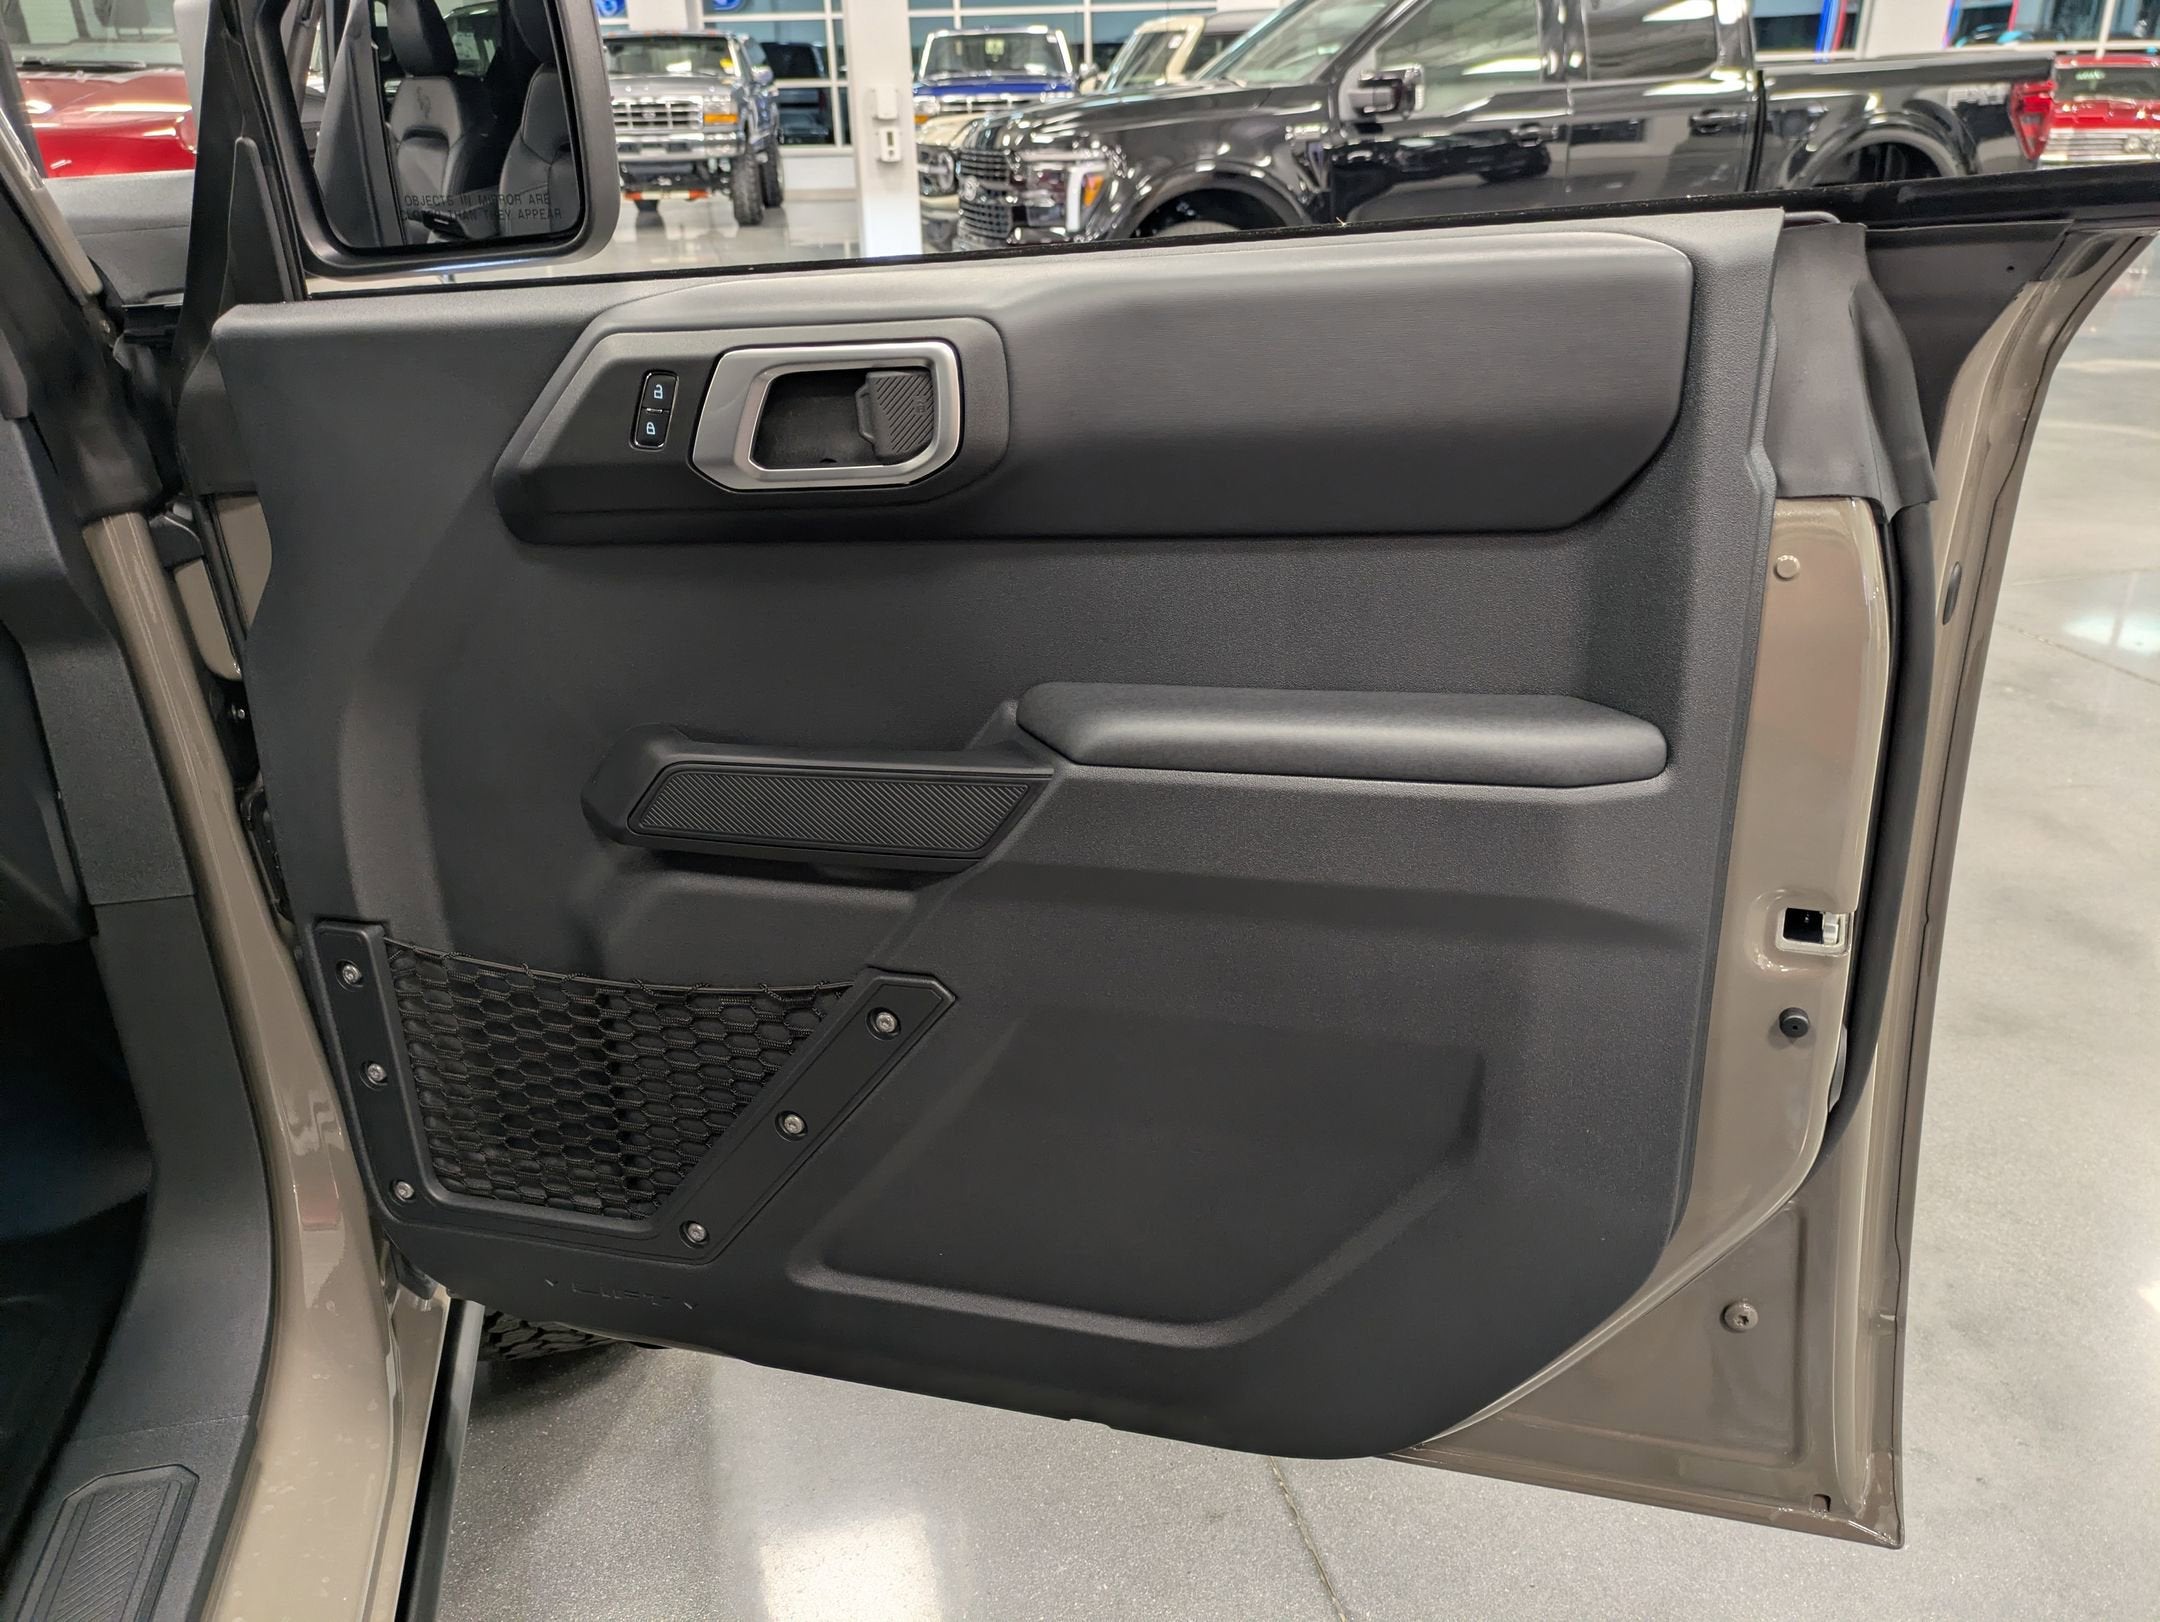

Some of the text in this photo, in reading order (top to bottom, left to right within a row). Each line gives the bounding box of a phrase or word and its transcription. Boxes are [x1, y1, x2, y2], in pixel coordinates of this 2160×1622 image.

[404, 194, 455, 207] OBJECTS
[529, 193, 551, 205] ARE
[518, 208, 562, 220] APPEAR
